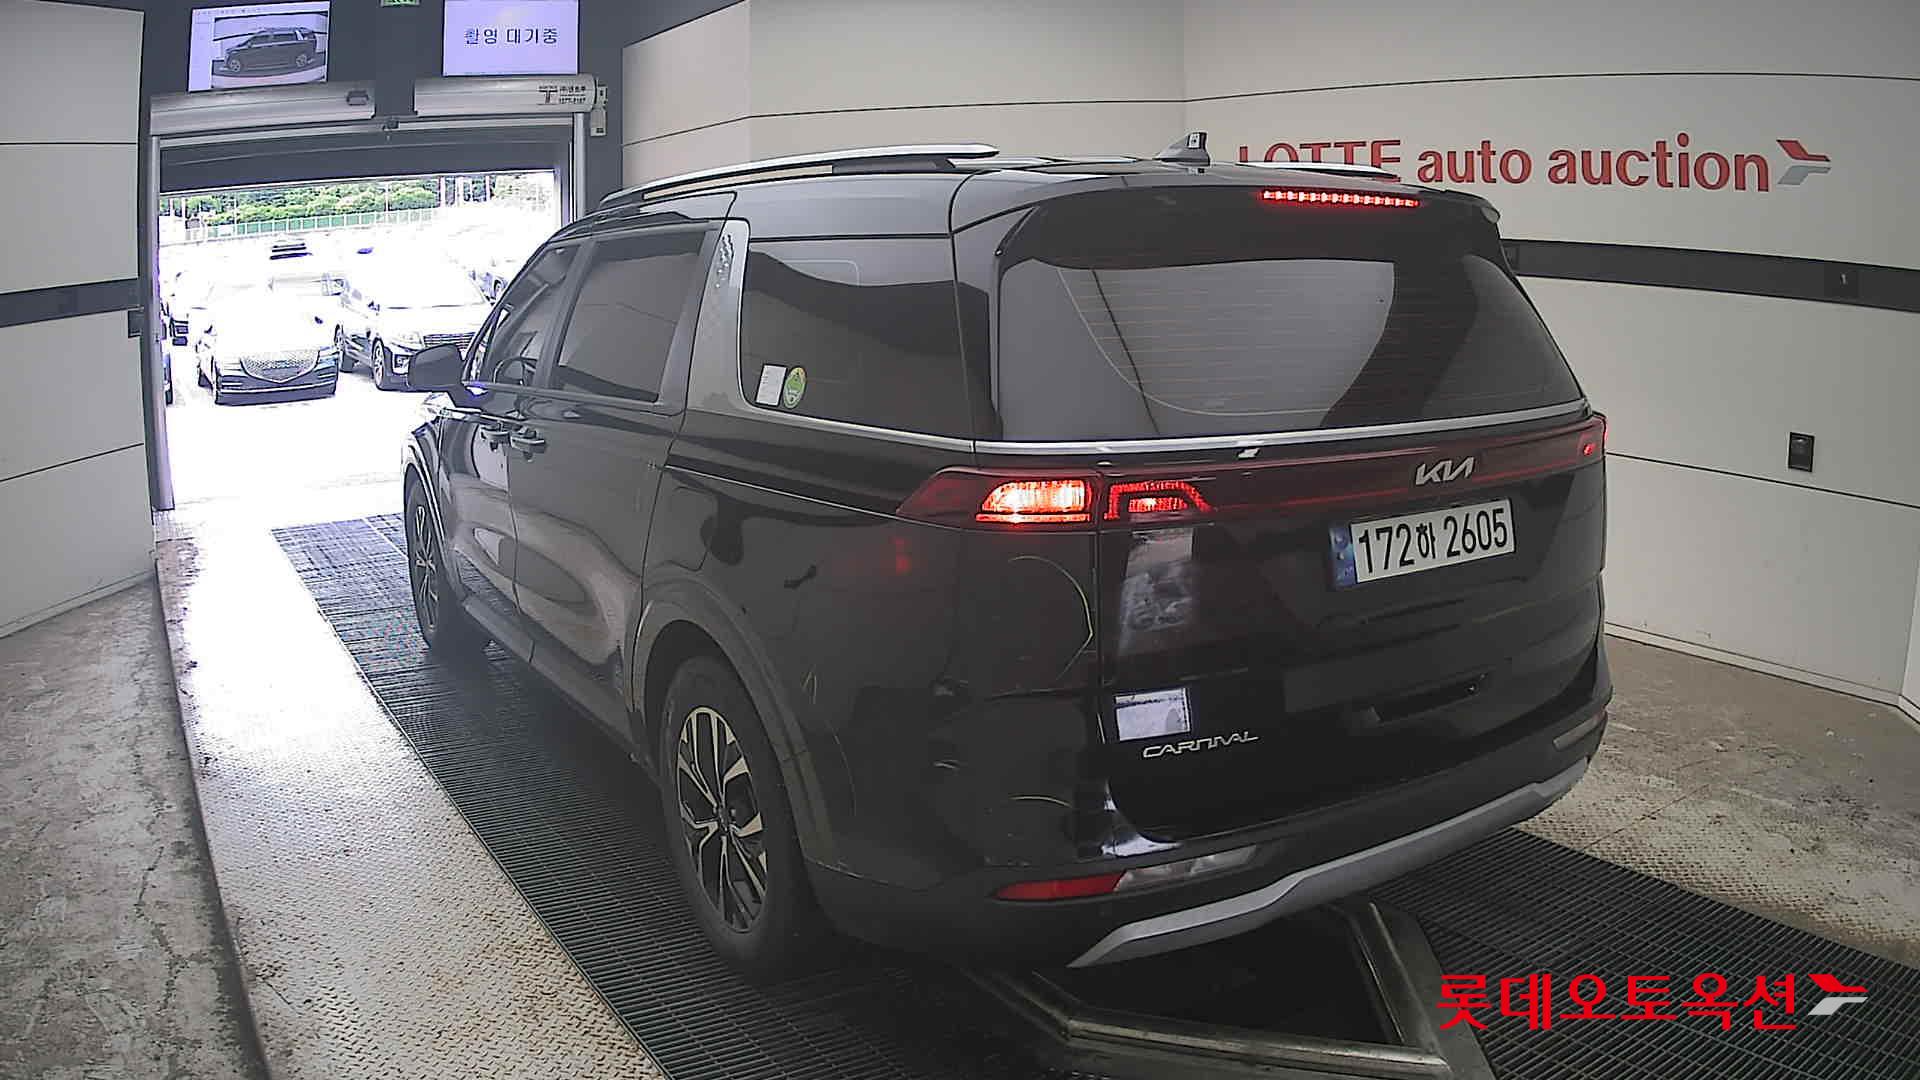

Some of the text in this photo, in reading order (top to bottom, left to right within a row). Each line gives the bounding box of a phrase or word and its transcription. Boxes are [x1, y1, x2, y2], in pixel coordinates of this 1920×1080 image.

[506, 28, 559, 44] 대기중
[1418, 140, 1532, 184] auto
[1548, 133, 1769, 192] auction
[1415, 456, 1475, 485] KIA
[1358, 507, 1508, 574] 172하 2605
[1142, 731, 1259, 758] CARNIVAL
